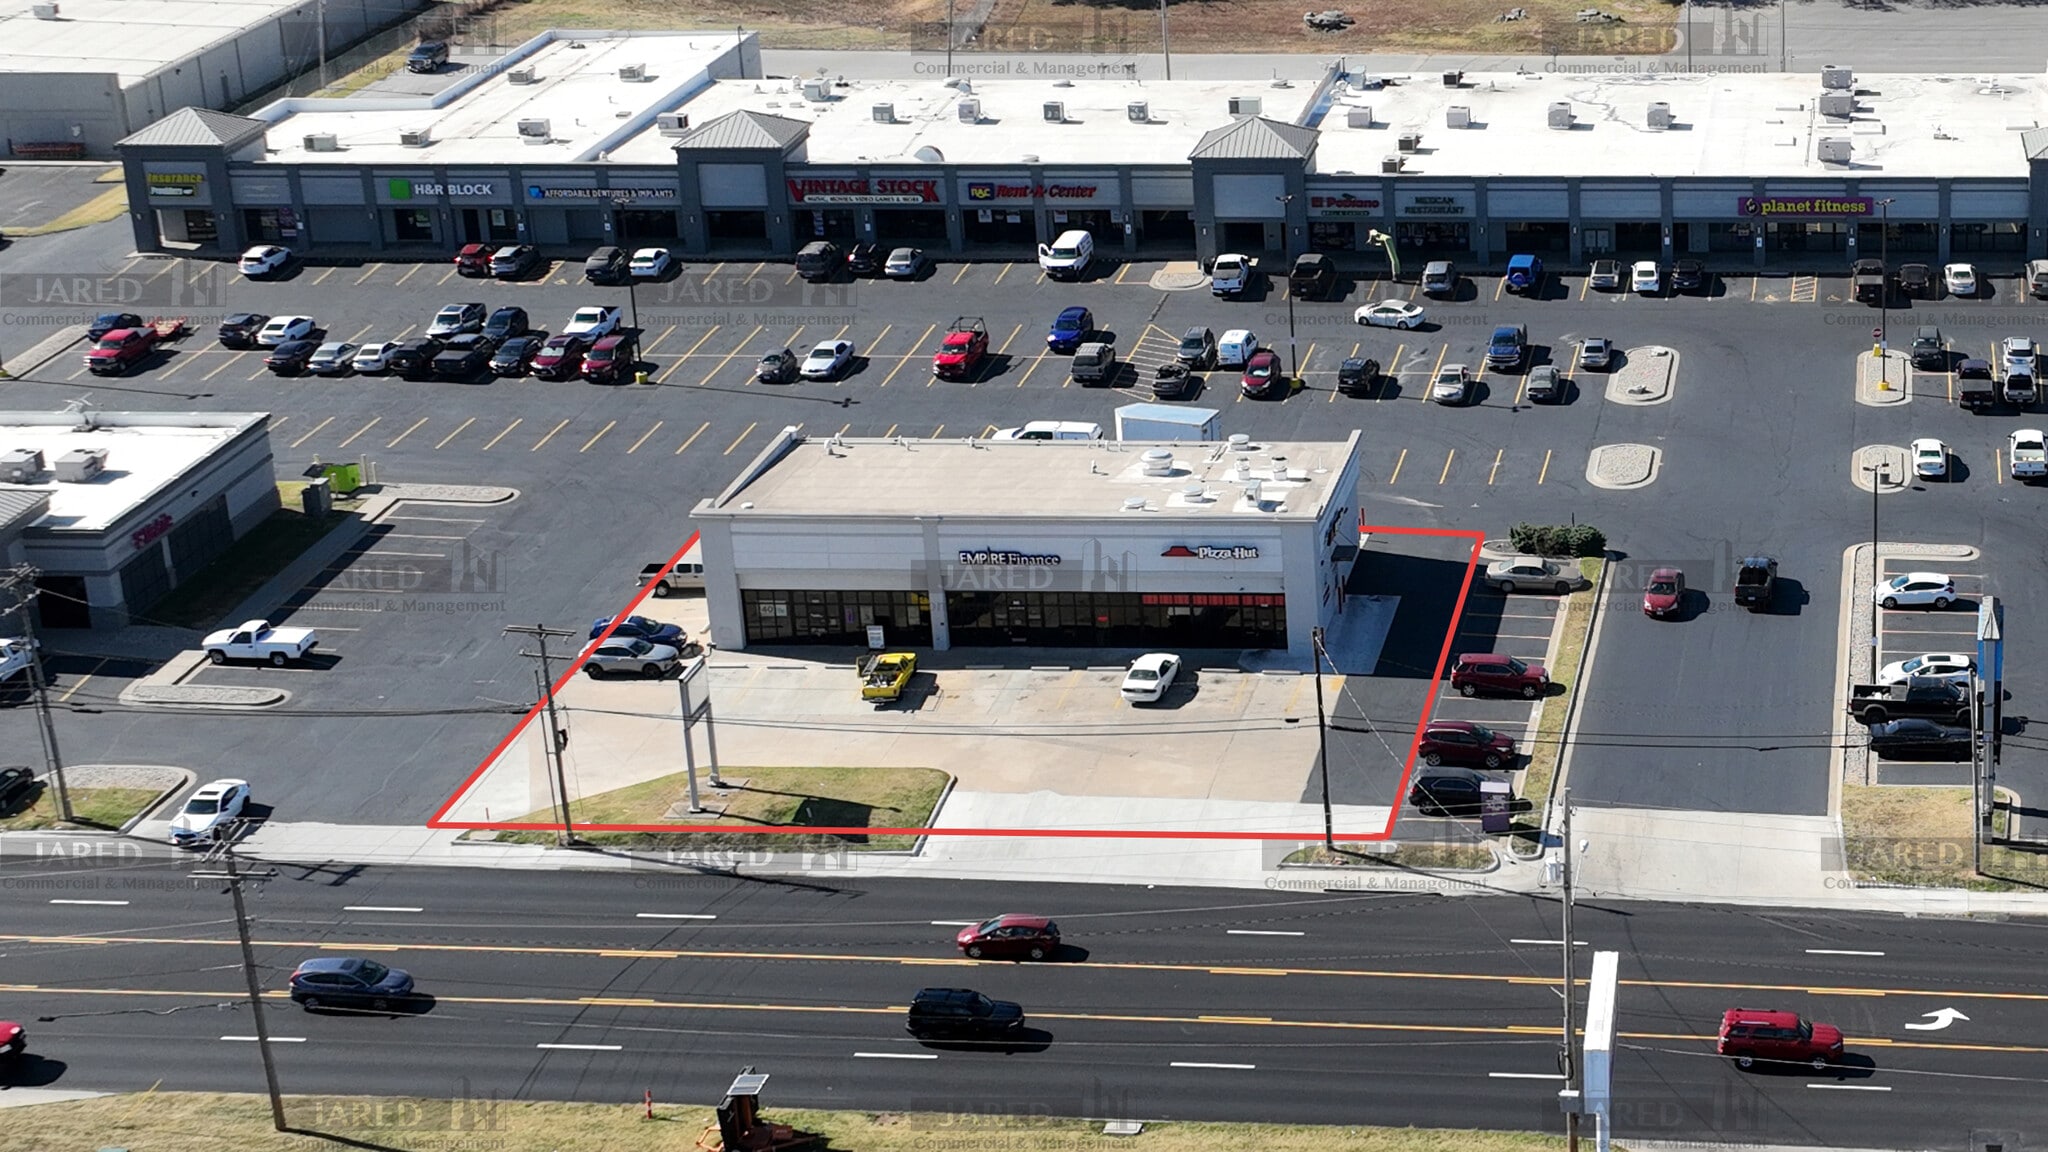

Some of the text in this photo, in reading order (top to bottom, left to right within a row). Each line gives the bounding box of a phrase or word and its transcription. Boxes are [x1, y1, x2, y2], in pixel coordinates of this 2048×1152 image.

[414, 184, 493, 195] H&R BLOCK
[544, 189, 590, 198] AFFORDABLE
[592, 189, 629, 198] DENTURES
[638, 189, 674, 198] IMPLANTS
[787, 179, 940, 203] VINTAGE STOCK
[1761, 199, 1866, 215] planet fitness
[960, 550, 1060, 565] EMPIRE Finance
[1199, 547, 1259, 559] Pizza Hut
